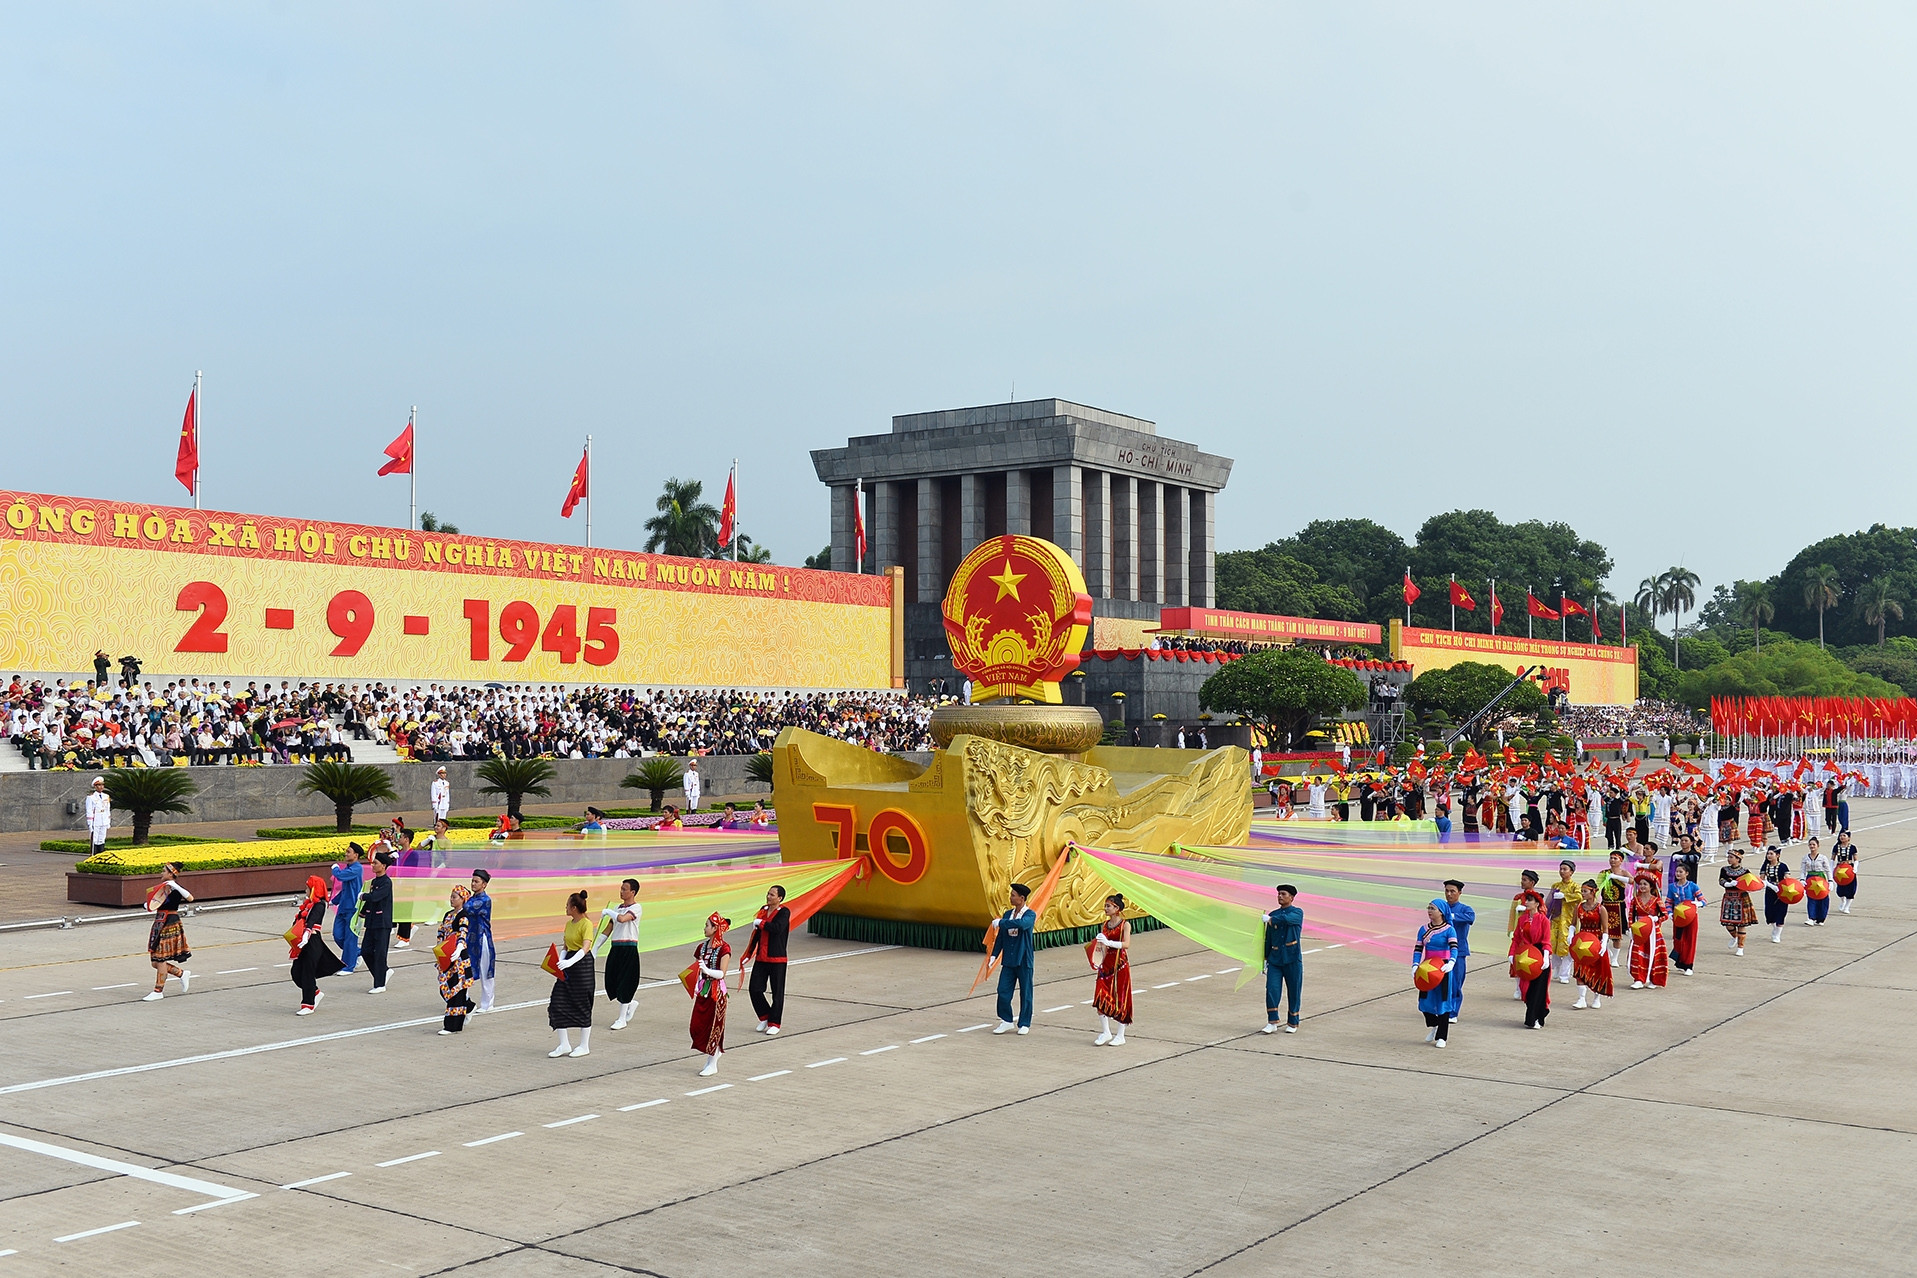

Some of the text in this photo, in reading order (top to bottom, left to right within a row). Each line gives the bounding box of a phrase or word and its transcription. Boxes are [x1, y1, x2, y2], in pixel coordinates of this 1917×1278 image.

[113, 510, 195, 544] HÒA
[209, 519, 261, 550] XÃ
[273, 525, 336, 559] HỘI
[349, 533, 411, 562] CHỦ
[423, 540, 515, 569] NGHĨA
[524, 547, 585, 579] VIỆT
[593, 557, 649, 582] NAM
[656, 563, 722, 588] MUÔN
[729, 569, 777, 592] NĂM
[172, 581, 230, 655] 2
[325, 589, 376, 658] 9
[463, 598, 620, 667] 1945
[1235, 615, 1250, 629] CÁCH
[1268, 618, 1285, 632] THÁNG
[1420, 631, 1434, 644] CHỦ
[1436, 633, 1452, 647] TỊCH
[1453, 632, 1463, 646] HỒ
[1464, 636, 1476, 648] CHÍ
[1477, 638, 1494, 649] MINH
[1514, 639, 1529, 652] SỐNG
[1541, 644, 1559, 655] TRONG
[1567, 645, 1586, 658] NGHIỆP
[1597, 648, 1613, 659] CHÚNG
[985, 670, 1027, 682] VIỆT NAM
[811, 802, 932, 886] 70
